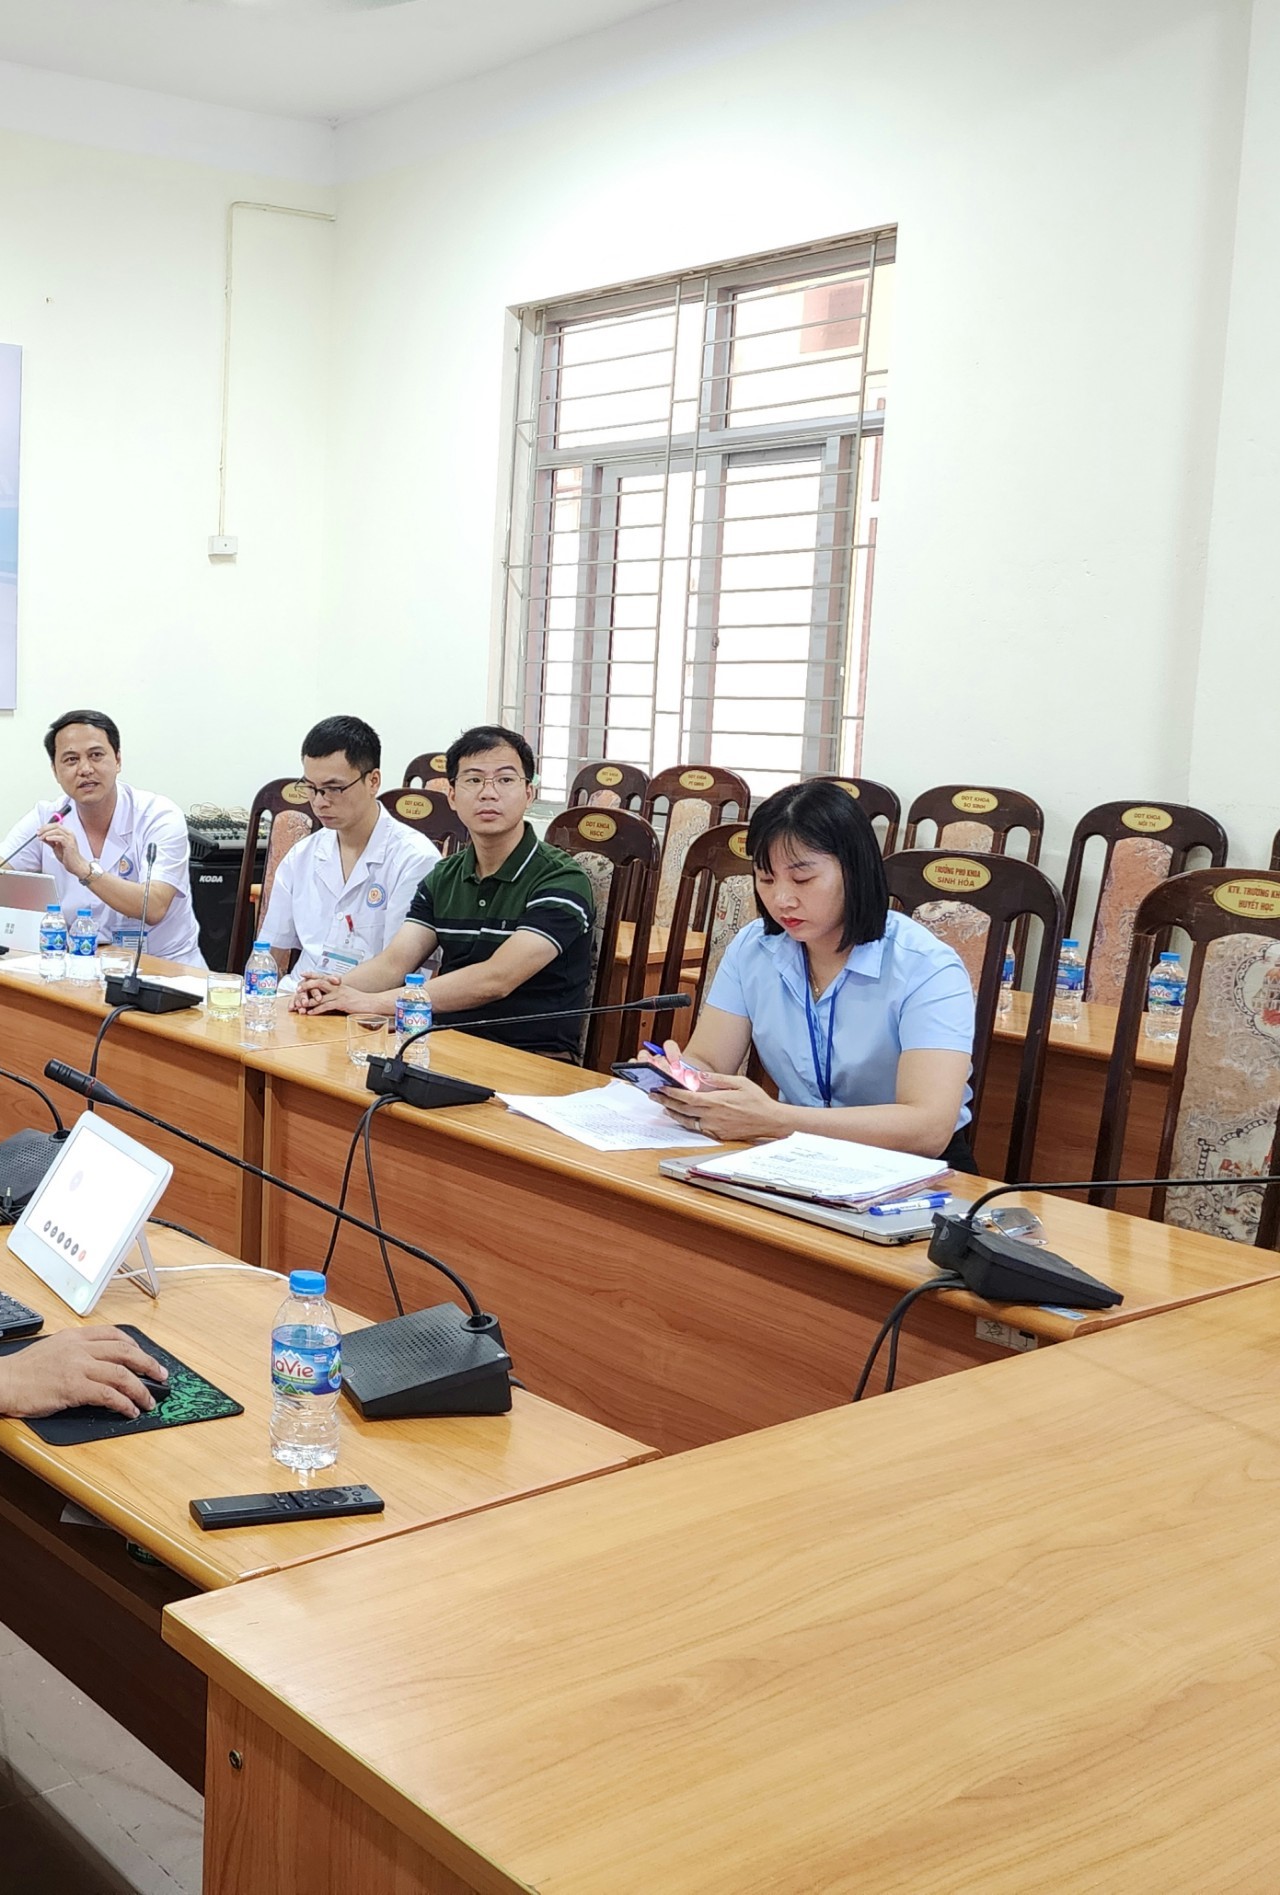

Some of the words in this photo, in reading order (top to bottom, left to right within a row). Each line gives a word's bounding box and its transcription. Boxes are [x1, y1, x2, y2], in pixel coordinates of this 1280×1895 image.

[199, 875, 223, 883] KODA
[937, 876, 955, 885] SINH
[272, 1356, 315, 1379] aVie
